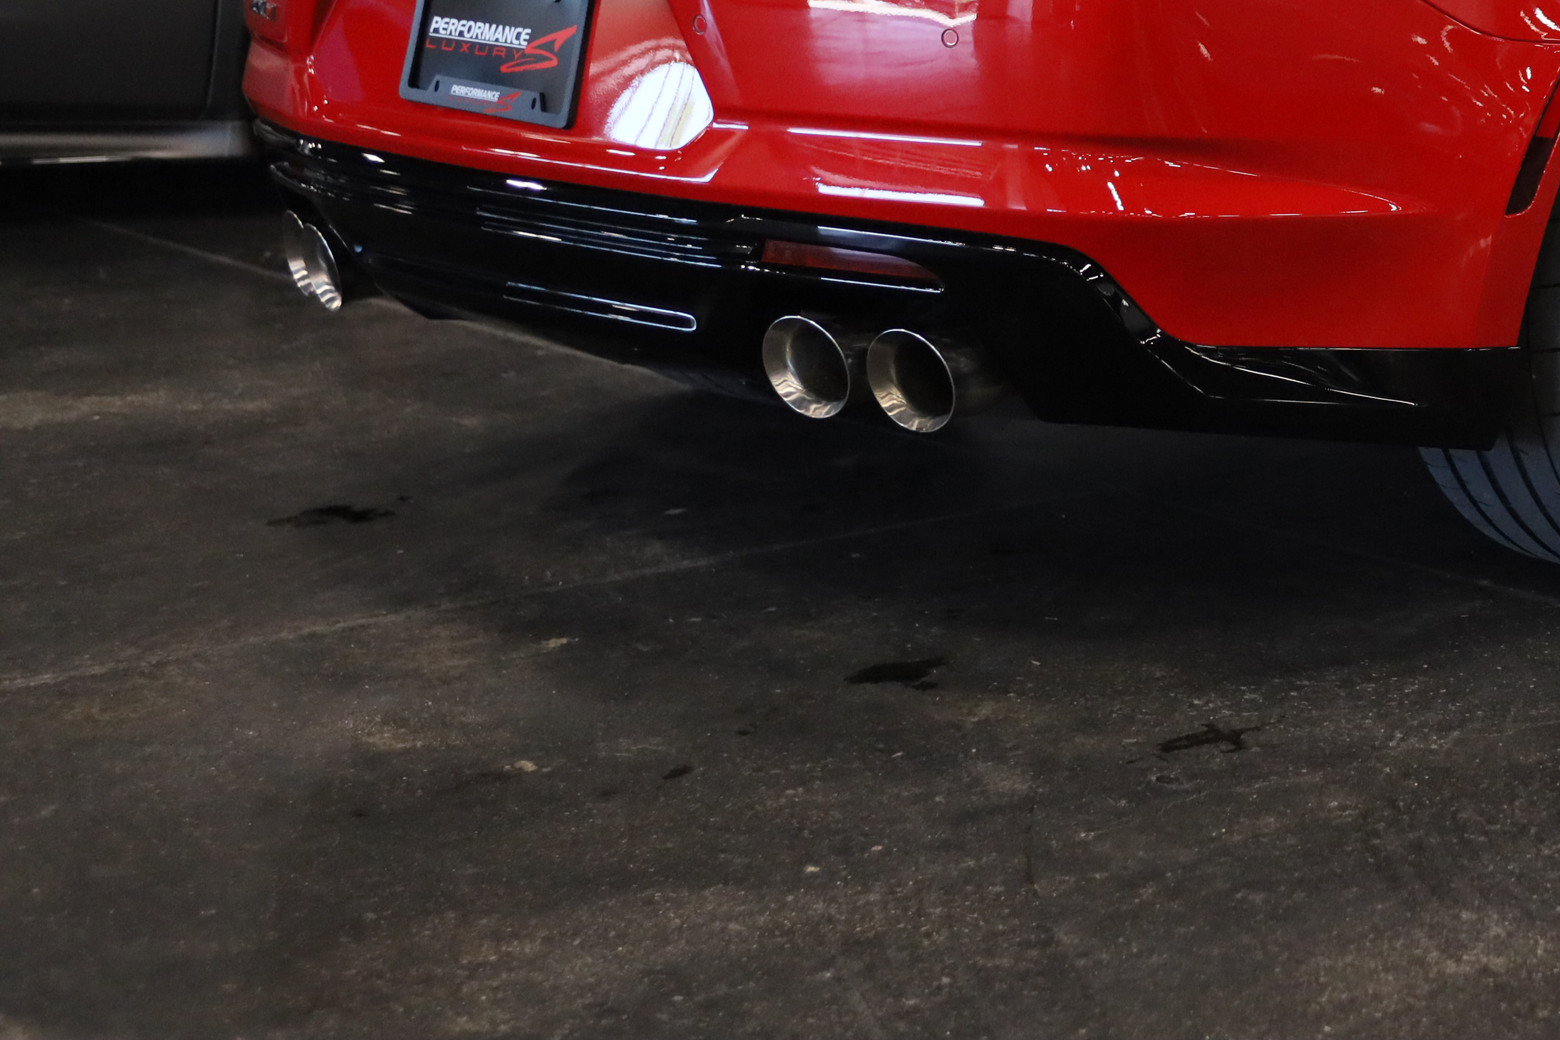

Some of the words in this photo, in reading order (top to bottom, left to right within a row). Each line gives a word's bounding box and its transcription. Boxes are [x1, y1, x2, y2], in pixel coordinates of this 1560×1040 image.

[429, 15, 532, 46] PERFORMANCE
[425, 37, 526, 61] LUXURY
[450, 84, 501, 103] PERFORMANCE
